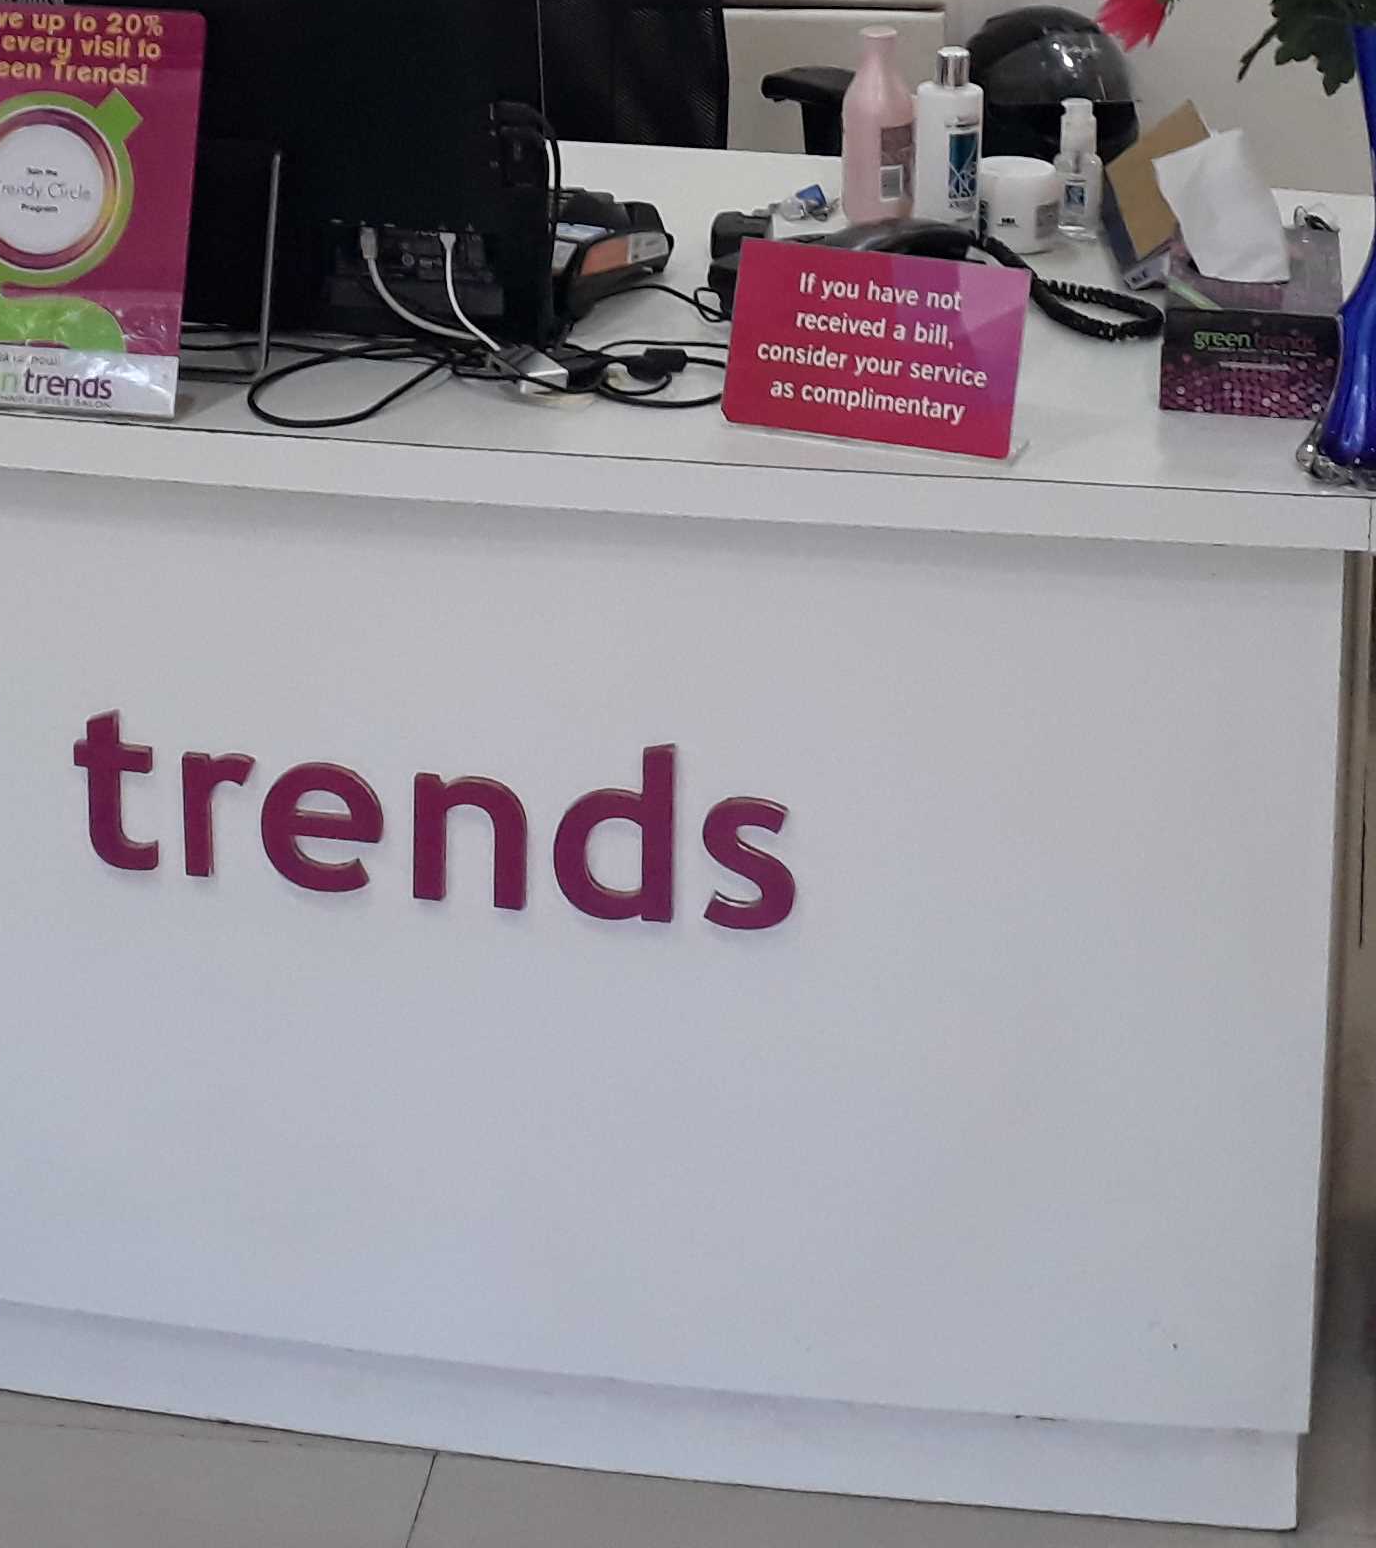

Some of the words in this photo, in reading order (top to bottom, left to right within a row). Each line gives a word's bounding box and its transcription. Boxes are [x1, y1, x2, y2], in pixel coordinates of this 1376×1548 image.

[32, 12, 65, 35] up
[74, 11, 97, 32] to
[106, 12, 164, 36] 20%
[1, 33, 73, 60] every
[80, 34, 132, 58] visit
[137, 38, 162, 60] to
[50, 57, 149, 86] Trends!
[798, 271, 816, 294] If
[820, 280, 860, 301] you
[867, 279, 919, 307] have
[925, 290, 962, 312] not
[795, 310, 886, 340] received
[892, 324, 907, 340] a
[914, 324, 954, 351] bill,
[1193, 331, 1252, 351] green
[757, 341, 849, 369] consider
[854, 353, 903, 378] your
[909, 362, 988, 389] service
[24, 367, 114, 401] trends
[770, 378, 795, 400] as
[801, 381, 967, 426] complimentary
[72, 709, 799, 931] trends
